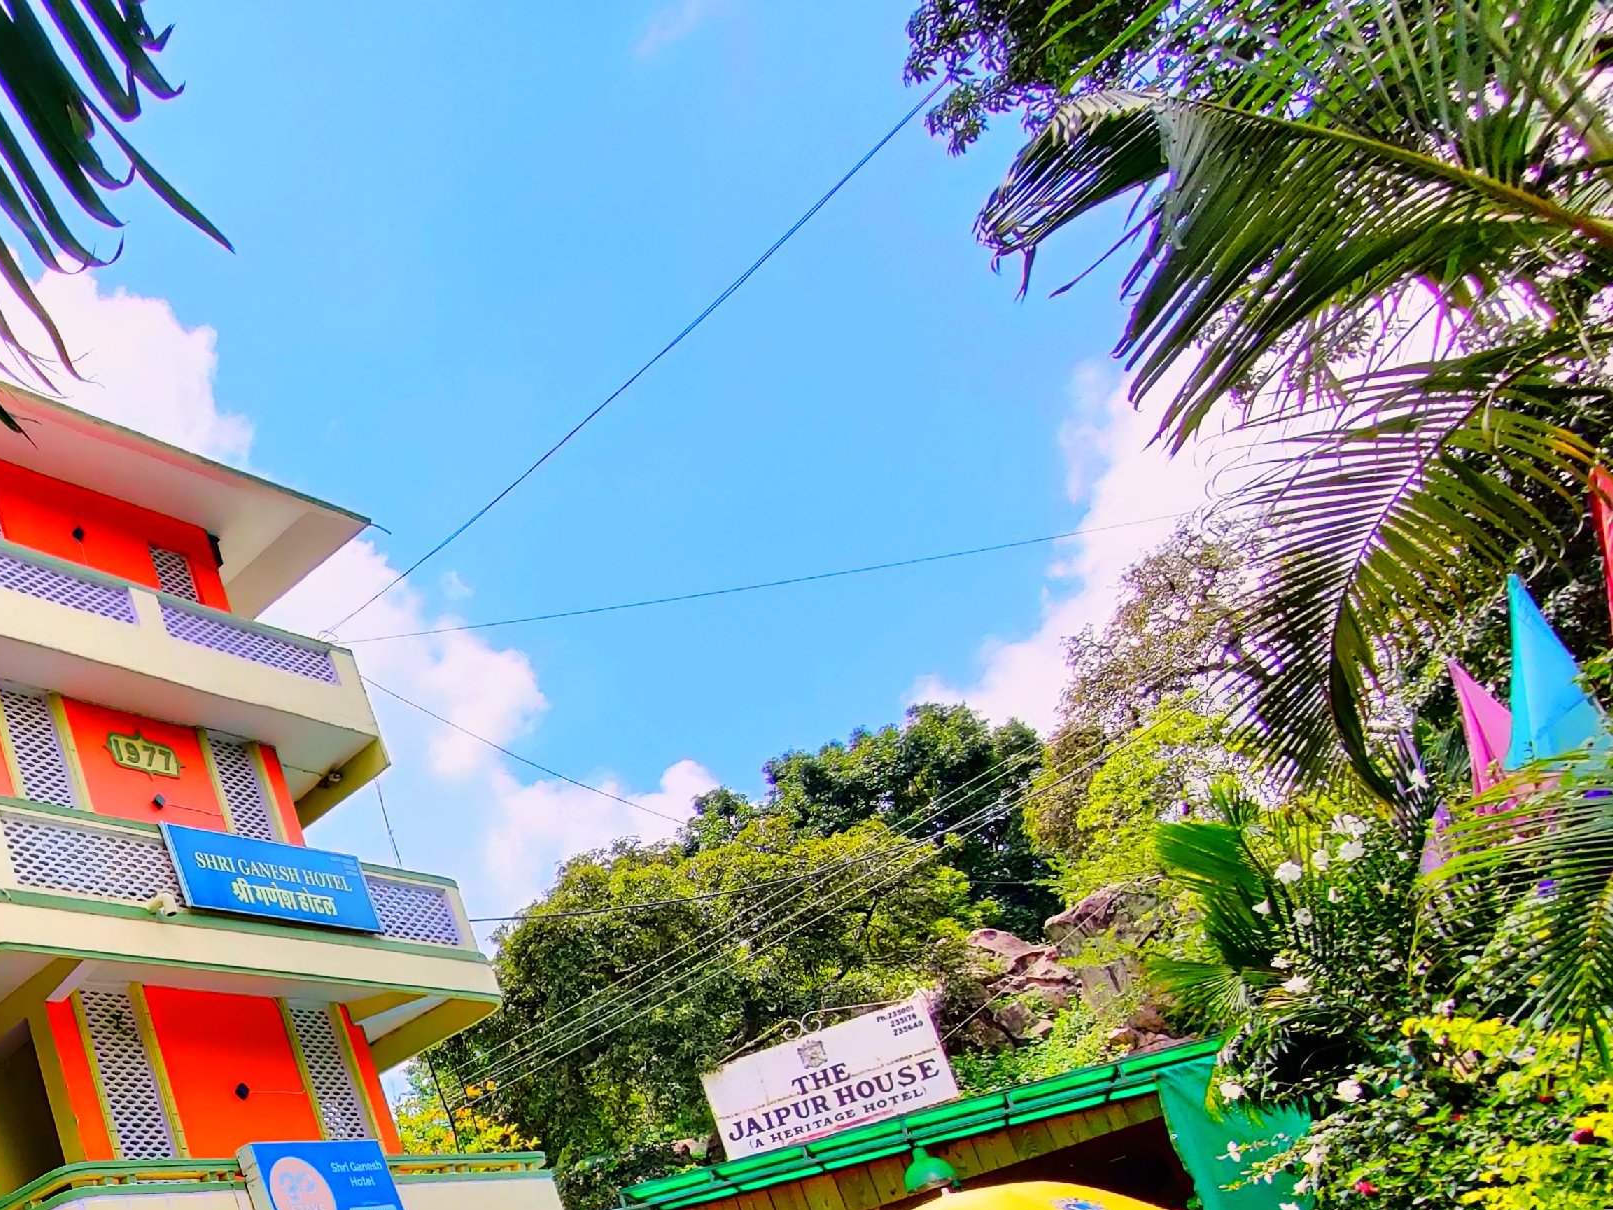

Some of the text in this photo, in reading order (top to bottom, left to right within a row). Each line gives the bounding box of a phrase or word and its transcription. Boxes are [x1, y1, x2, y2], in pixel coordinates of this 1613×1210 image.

[112, 737, 172, 772] 1977
[194, 851, 352, 893] SHRI GANESH HOTEL
[231, 877, 338, 915] श्री गणेश होटल
[791, 1062, 851, 1095] THE
[729, 1058, 940, 1142] JAIPUR HOUSE
[771, 1109, 856, 1142] HERITAGE
[863, 1087, 927, 1114] HOTEL)
[330, 1161, 383, 1173] Shri Ganesh
[350, 1176, 376, 1187] Hotel
[279, 1172, 317, 1204] go
